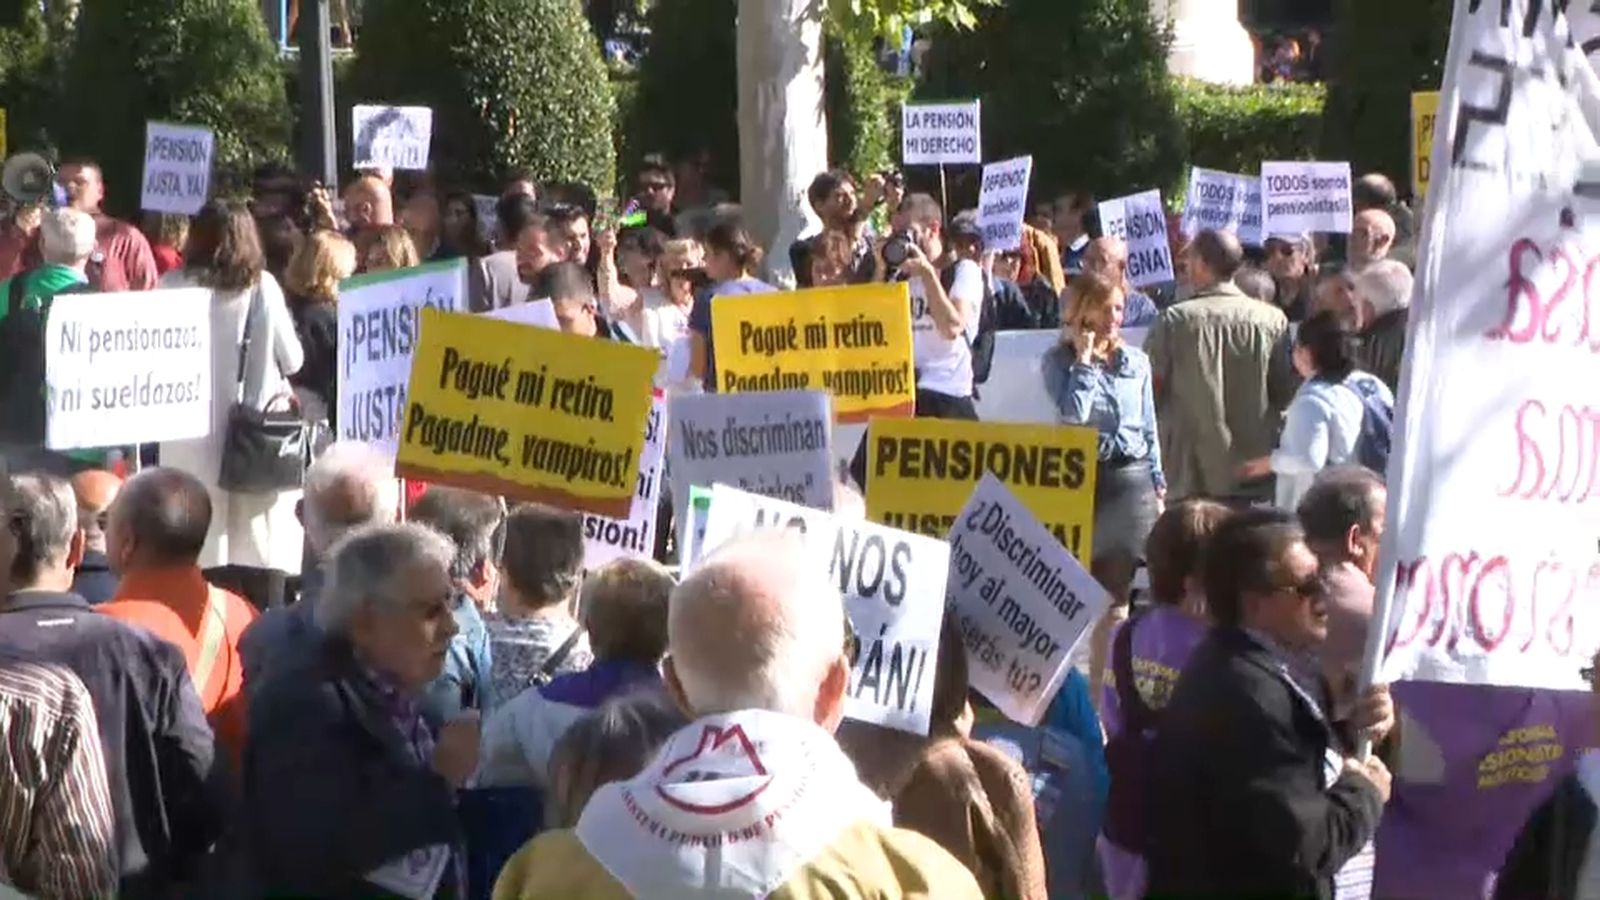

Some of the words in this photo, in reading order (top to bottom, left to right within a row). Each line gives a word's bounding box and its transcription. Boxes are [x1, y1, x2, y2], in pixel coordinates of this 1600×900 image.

[905, 113, 920, 129] LA
[920, 137, 974, 155] DERECHO
[1266, 174, 1309, 191] TODOS
[1311, 176, 1349, 190] somos
[1126, 246, 1172, 278] GNA!
[60, 321, 81, 354] Ni
[740, 317, 799, 357] Pagué
[804, 316, 828, 350] mi
[833, 314, 889, 348] retiro.
[61, 378, 81, 411] ni
[91, 371, 201, 410] sueldazos!
[439, 346, 511, 401] Pagué
[514, 365, 547, 409] mi
[550, 376, 614, 423] retiro.
[822, 361, 910, 399] vampiros!
[404, 402, 511, 467] Pagadme,
[521, 436, 633, 488] vampiros!
[680, 419, 718, 461] Nos
[721, 412, 826, 458] discriminan
[875, 435, 1085, 490] PENSIONES
[828, 527, 912, 607] NOS
[965, 500, 1087, 621] ¿Discriminar
[979, 576, 1001, 607] al
[998, 598, 1061, 662] mayor
[1009, 657, 1042, 697] tú?
